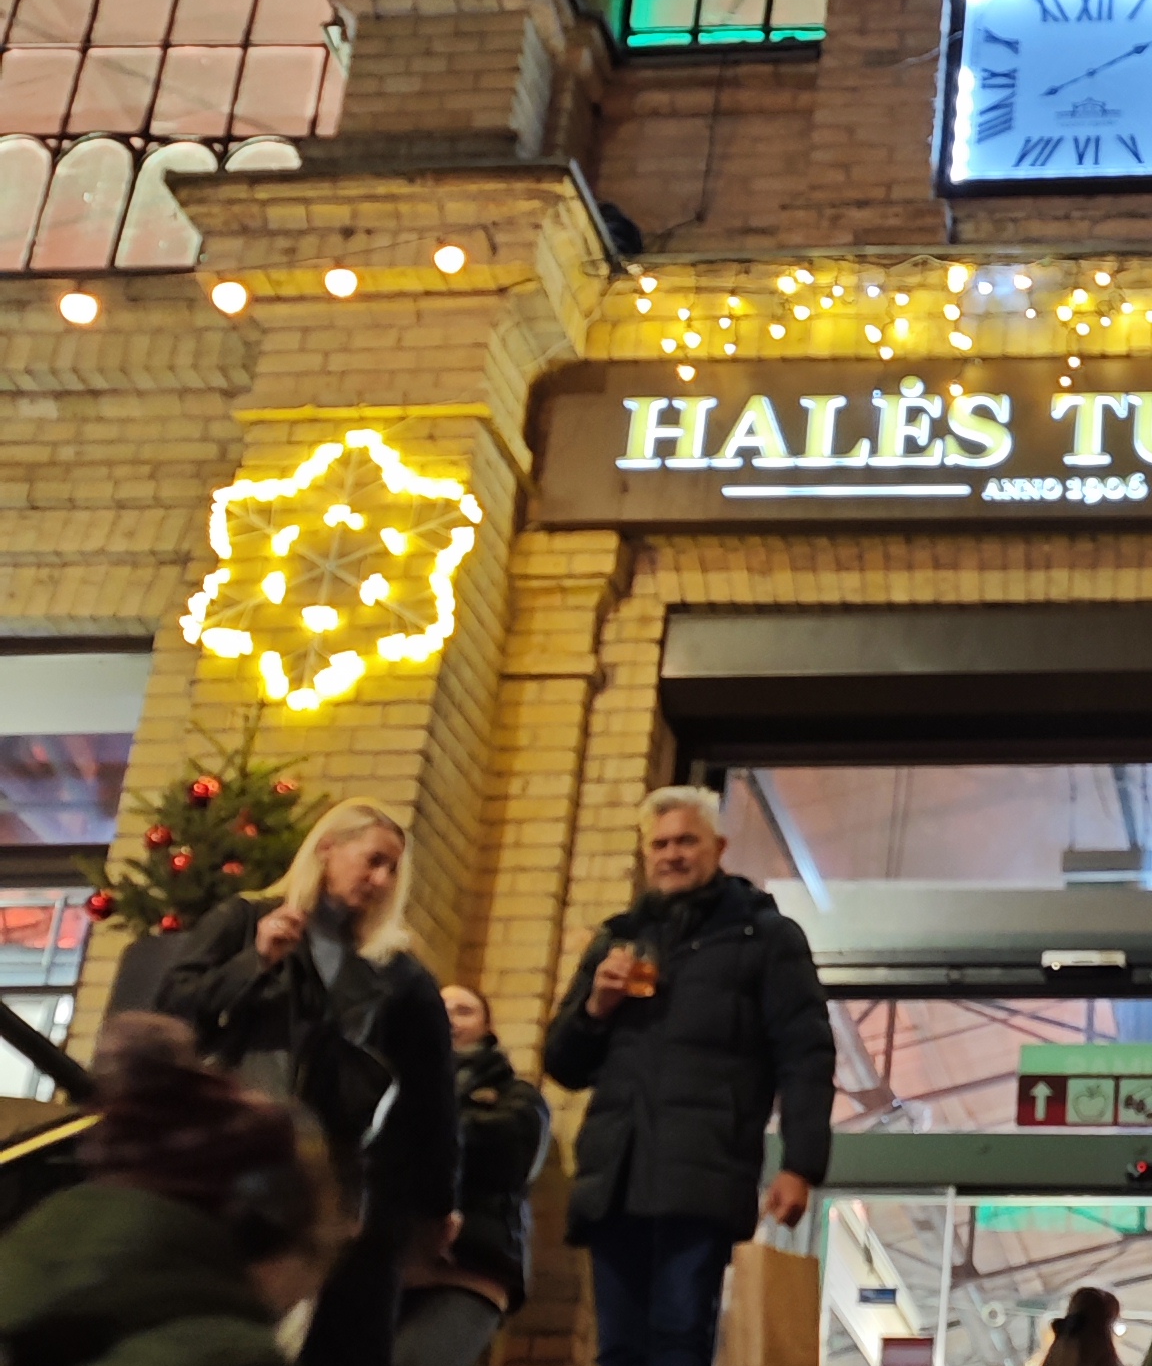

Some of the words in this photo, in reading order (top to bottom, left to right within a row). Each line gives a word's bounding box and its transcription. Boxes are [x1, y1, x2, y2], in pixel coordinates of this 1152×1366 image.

[1072, 134, 1100, 166] VI
[614, 375, 1014, 471] HALĖS
[981, 477, 1063, 501] ANNO
[1064, 471, 1149, 505] 1906
